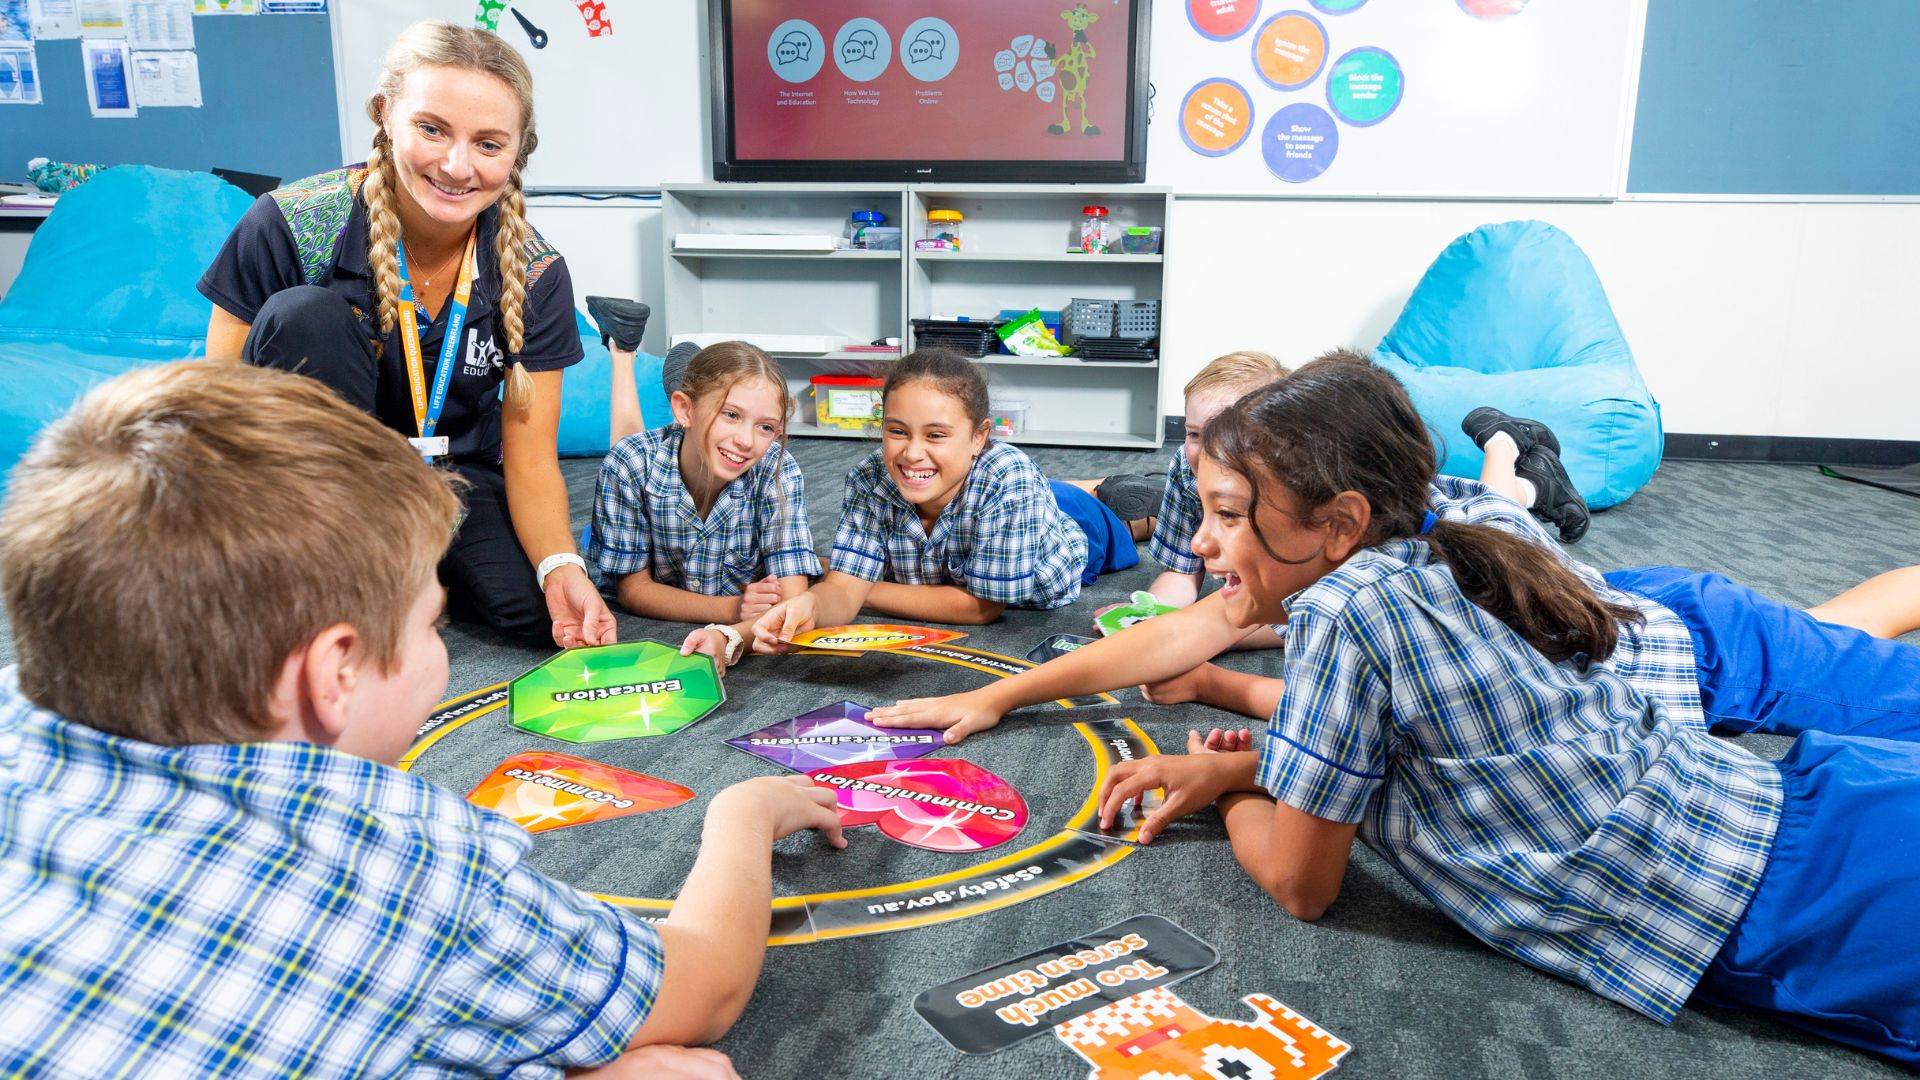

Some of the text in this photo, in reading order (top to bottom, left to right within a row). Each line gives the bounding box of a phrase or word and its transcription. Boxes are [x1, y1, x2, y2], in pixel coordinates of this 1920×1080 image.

[1273, 48, 1304, 62] message
[1275, 37, 1310, 55] Ignore the
[1349, 73, 1384, 81] Block the
[1196, 119, 1225, 138] message
[1278, 133, 1324, 143] the message
[1286, 151, 1312, 159] friends
[403, 310, 424, 409] LIFE EDUCATION QUEENSLAND
[433, 313, 461, 409] LIFE EDUCATION QUEENSLAND
[555, 679, 681, 701] Education
[750, 735, 933, 746] Entertainment
[504, 768, 634, 809] e-commerce
[813, 773, 1016, 821] Communication
[867, 866, 1043, 915] eSafety.gov.au
[956, 933, 1148, 1008] screen time
[995, 959, 1168, 1026] Too much
